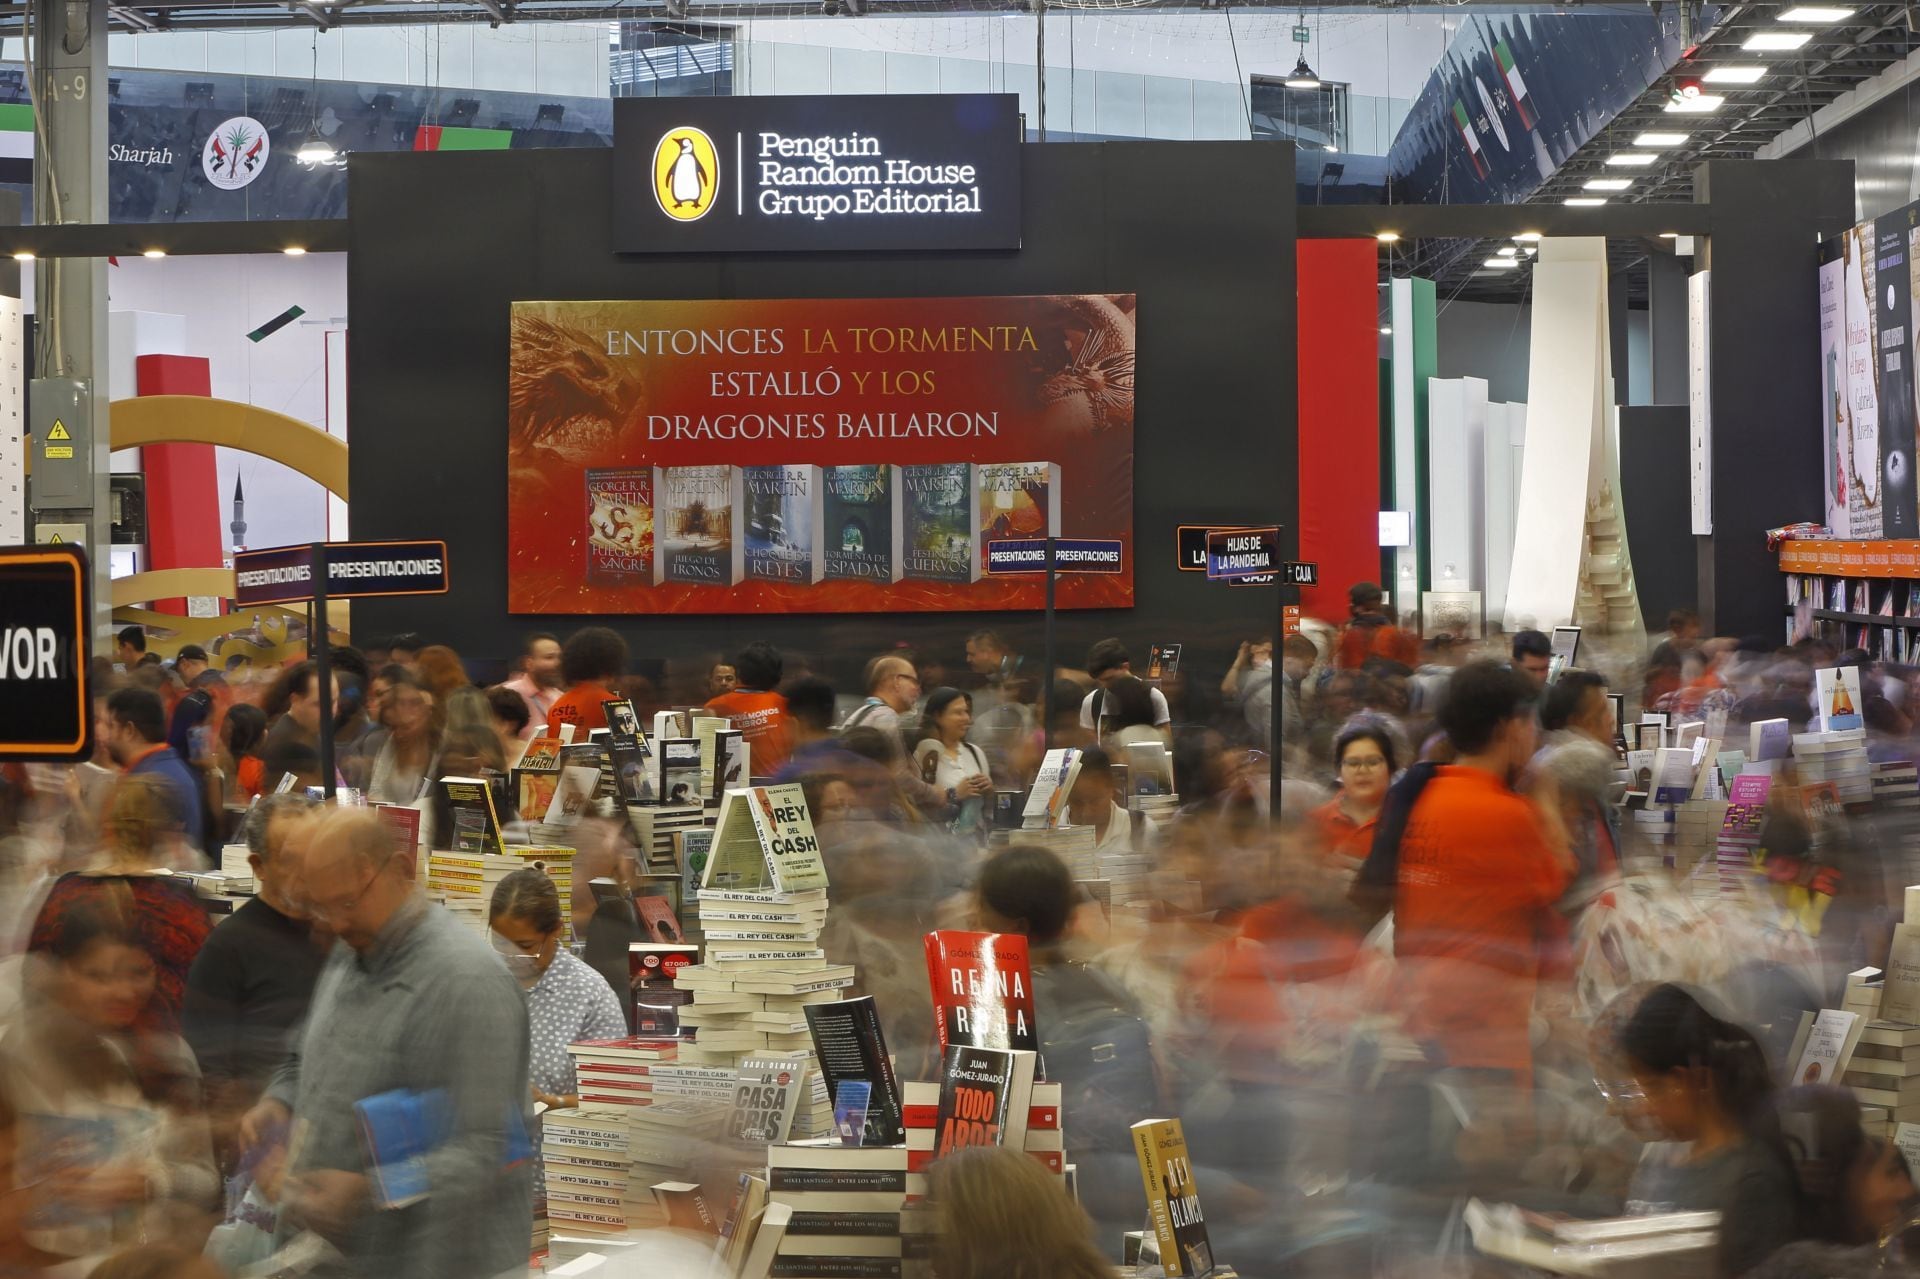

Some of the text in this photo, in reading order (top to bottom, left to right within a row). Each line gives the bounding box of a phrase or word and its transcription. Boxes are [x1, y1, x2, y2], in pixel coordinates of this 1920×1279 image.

[109, 143, 173, 167] Sharjah
[758, 131, 882, 163] Penguin
[758, 159, 976, 186] Random House
[758, 186, 982, 221] Grupo Editorial
[606, 326, 1040, 356] ENTONCES LA TORMENTA
[709, 366, 936, 397] ESTALLÓ Y LOS
[646, 411, 999, 440] DRAGONES BAILARON
[748, 471, 785, 480] GEORGE
[984, 467, 1021, 477] GEORGE
[588, 481, 627, 492] GEORGE
[749, 481, 807, 496] MARTIN
[906, 477, 966, 492] MARTIN
[984, 476, 1043, 491] MARTIN
[589, 492, 650, 506] MARTIN
[1227, 536, 1261, 552] HIJAS DE
[675, 555, 717, 566] JUEGO DE
[745, 549, 811, 562] CHOQUE DE
[825, 551, 887, 562] TORMENTA DE
[990, 550, 1119, 563] PRESENTACIONES PRESENTACIONES
[1193, 550, 1206, 564] LA
[1218, 552, 1270, 569] LA PANDEMIA
[238, 558, 442, 587] PRESENTACIONES PRESENTACIONES
[600, 557, 647, 572] SANGRE
[672, 564, 720, 577] TRONOS
[753, 561, 803, 578] REYES
[824, 560, 890, 578] ESPADAS
[903, 558, 968, 574] CUERVOS
[1295, 565, 1312, 583] CAJA
[736, 716, 768, 728] LIBROS
[521, 756, 552, 769] MÉXICO
[774, 805, 806, 824] REY
[755, 820, 761, 829] EL
[762, 843, 770, 855] DEL
[767, 856, 776, 876] CASH
[771, 835, 818, 856] CASH
[956, 1005, 1028, 1037] ROJA
[743, 1060, 798, 1071] RAÚL OLMOS
[969, 1059, 988, 1070] JUAN
[761, 1073, 772, 1084] LA
[950, 1066, 1004, 1084] GÓMEZ-JURADO
[735, 1086, 787, 1110] CASA
[955, 1086, 994, 1121] TODO
[727, 1109, 782, 1141] GRIS
[588, 1139, 600, 1147] REY
[602, 1132, 620, 1140] CASH
[604, 1160, 621, 1168] CASH
[1167, 1156, 1190, 1188] REY
[694, 1195, 711, 1226] FITZEK
[1169, 1194, 1204, 1229] BLANCO
[607, 1216, 624, 1224] CASH
[1152, 1199, 1170, 1242] REY BLANCO
